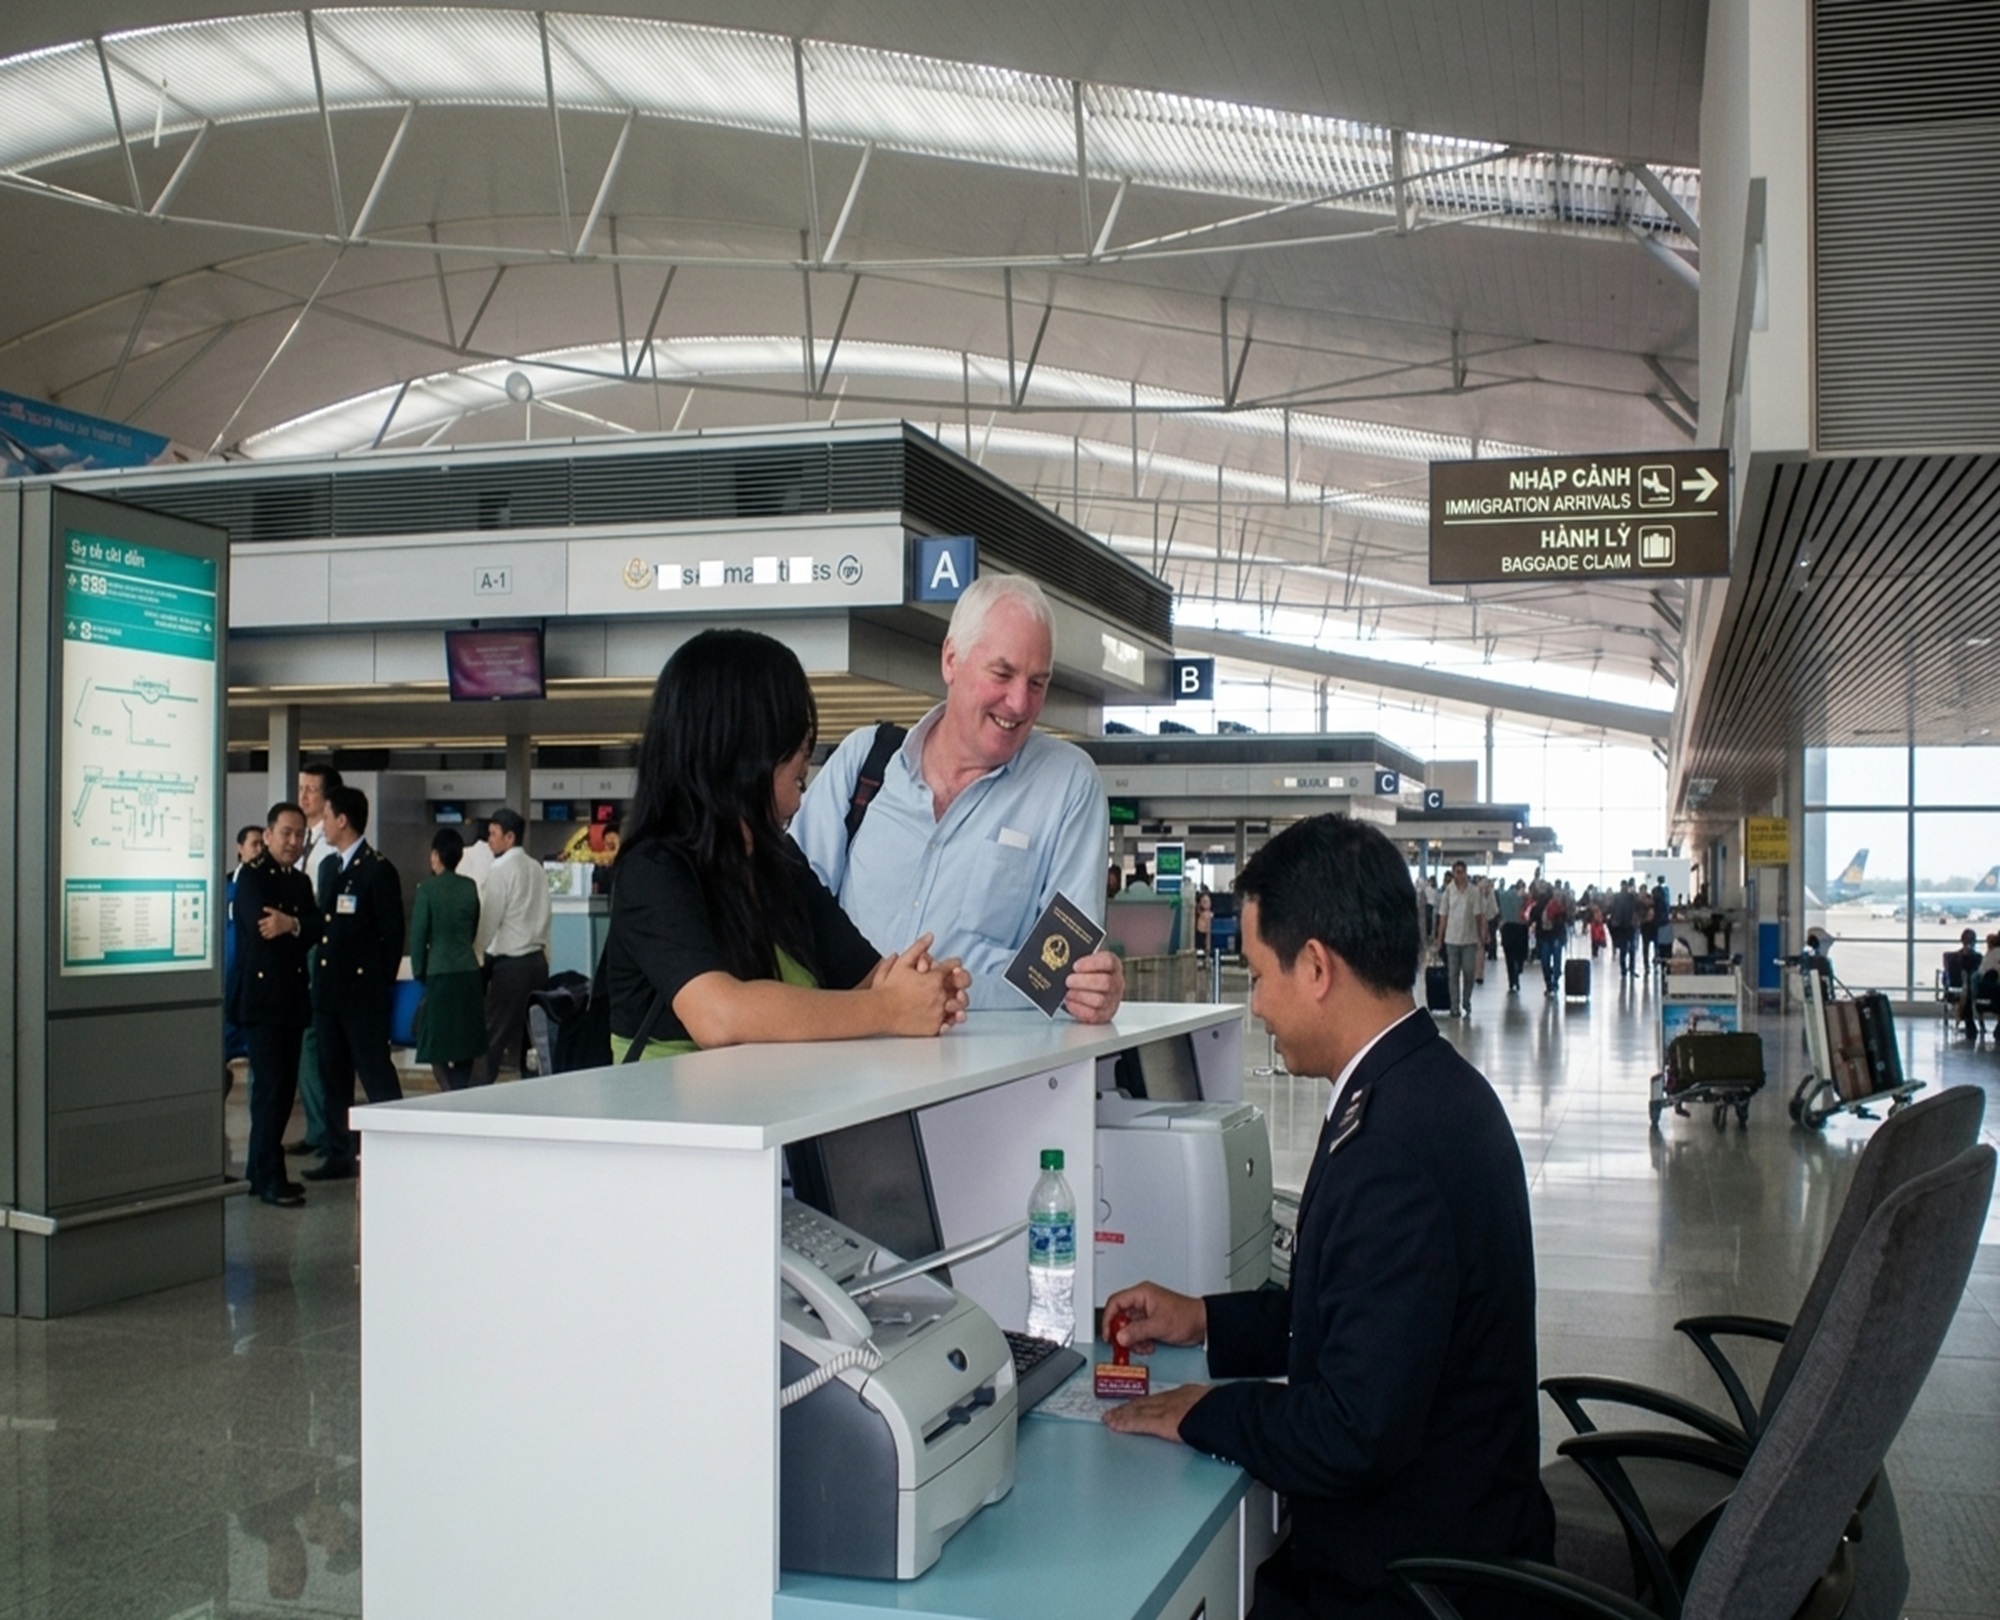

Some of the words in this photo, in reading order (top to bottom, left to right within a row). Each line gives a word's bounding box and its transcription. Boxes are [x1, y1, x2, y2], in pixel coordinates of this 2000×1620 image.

[1445, 495, 1549, 515] IMMIGRATION
[1553, 493, 1632, 512] ARRIVALS
[929, 550, 960, 589] A
[1582, 553, 1631, 571] CLAIM
[480, 571, 506, 589] A-1
[1181, 665, 1200, 693] B
[1381, 774, 1395, 792] C
[1428, 792, 1440, 808] C
